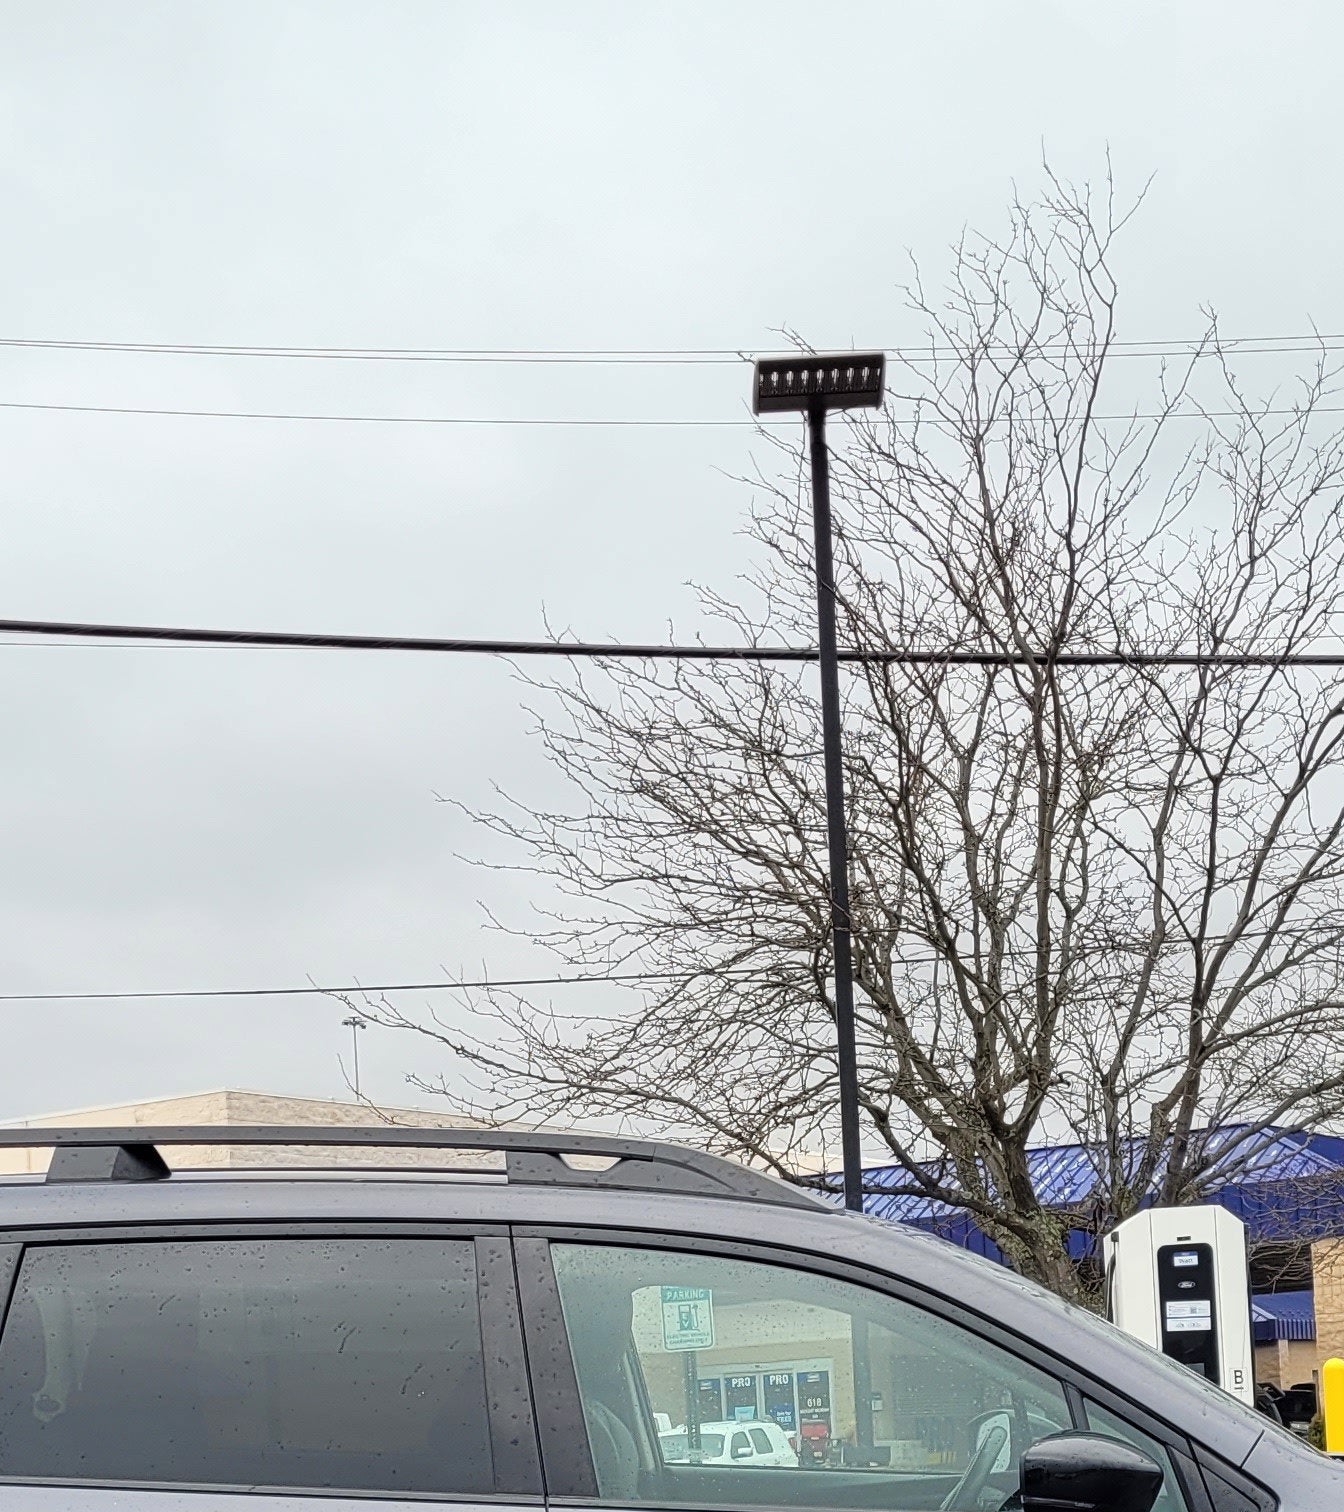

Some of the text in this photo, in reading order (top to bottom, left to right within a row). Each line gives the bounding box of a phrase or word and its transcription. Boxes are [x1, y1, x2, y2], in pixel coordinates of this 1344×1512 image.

[667, 1290, 705, 1300] PARKING
[731, 1374, 789, 1388] PRO PRO
[1234, 1370, 1244, 1384] B
